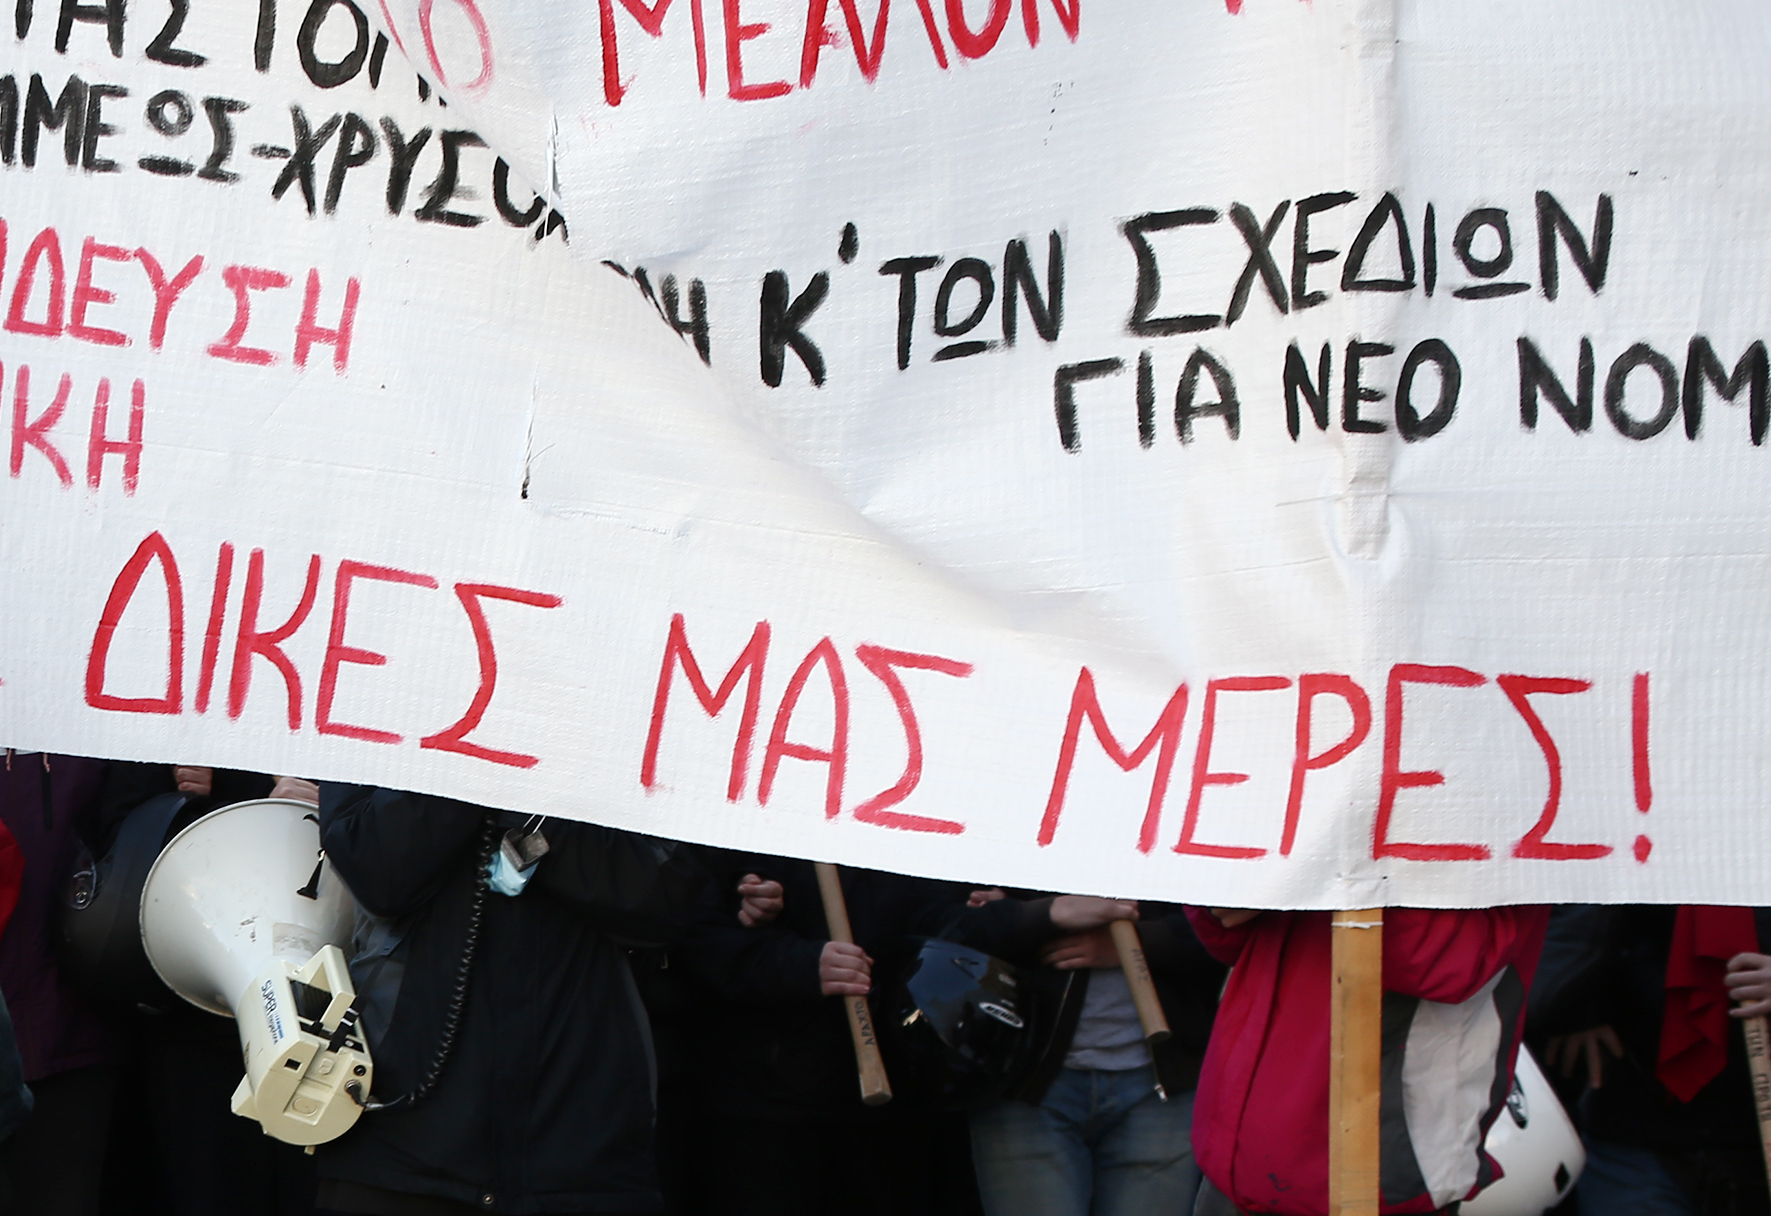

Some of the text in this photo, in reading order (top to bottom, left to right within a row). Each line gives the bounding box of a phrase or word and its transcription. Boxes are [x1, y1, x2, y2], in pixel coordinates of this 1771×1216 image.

[879, 228, 1068, 371] ΤΩΝ
[1120, 188, 1616, 338] ΣΧΕΔΙΩΝ
[1054, 349, 1242, 454] ΓΙΑ
[1284, 338, 1464, 442] ΝΕΟ
[84, 530, 564, 770] ΔΙΚΕΣ
[641, 612, 974, 836] ΜΑΣ
[1036, 662, 1656, 865] ΜΕΡΕΣ!
[261, 979, 278, 1017] SUPER
